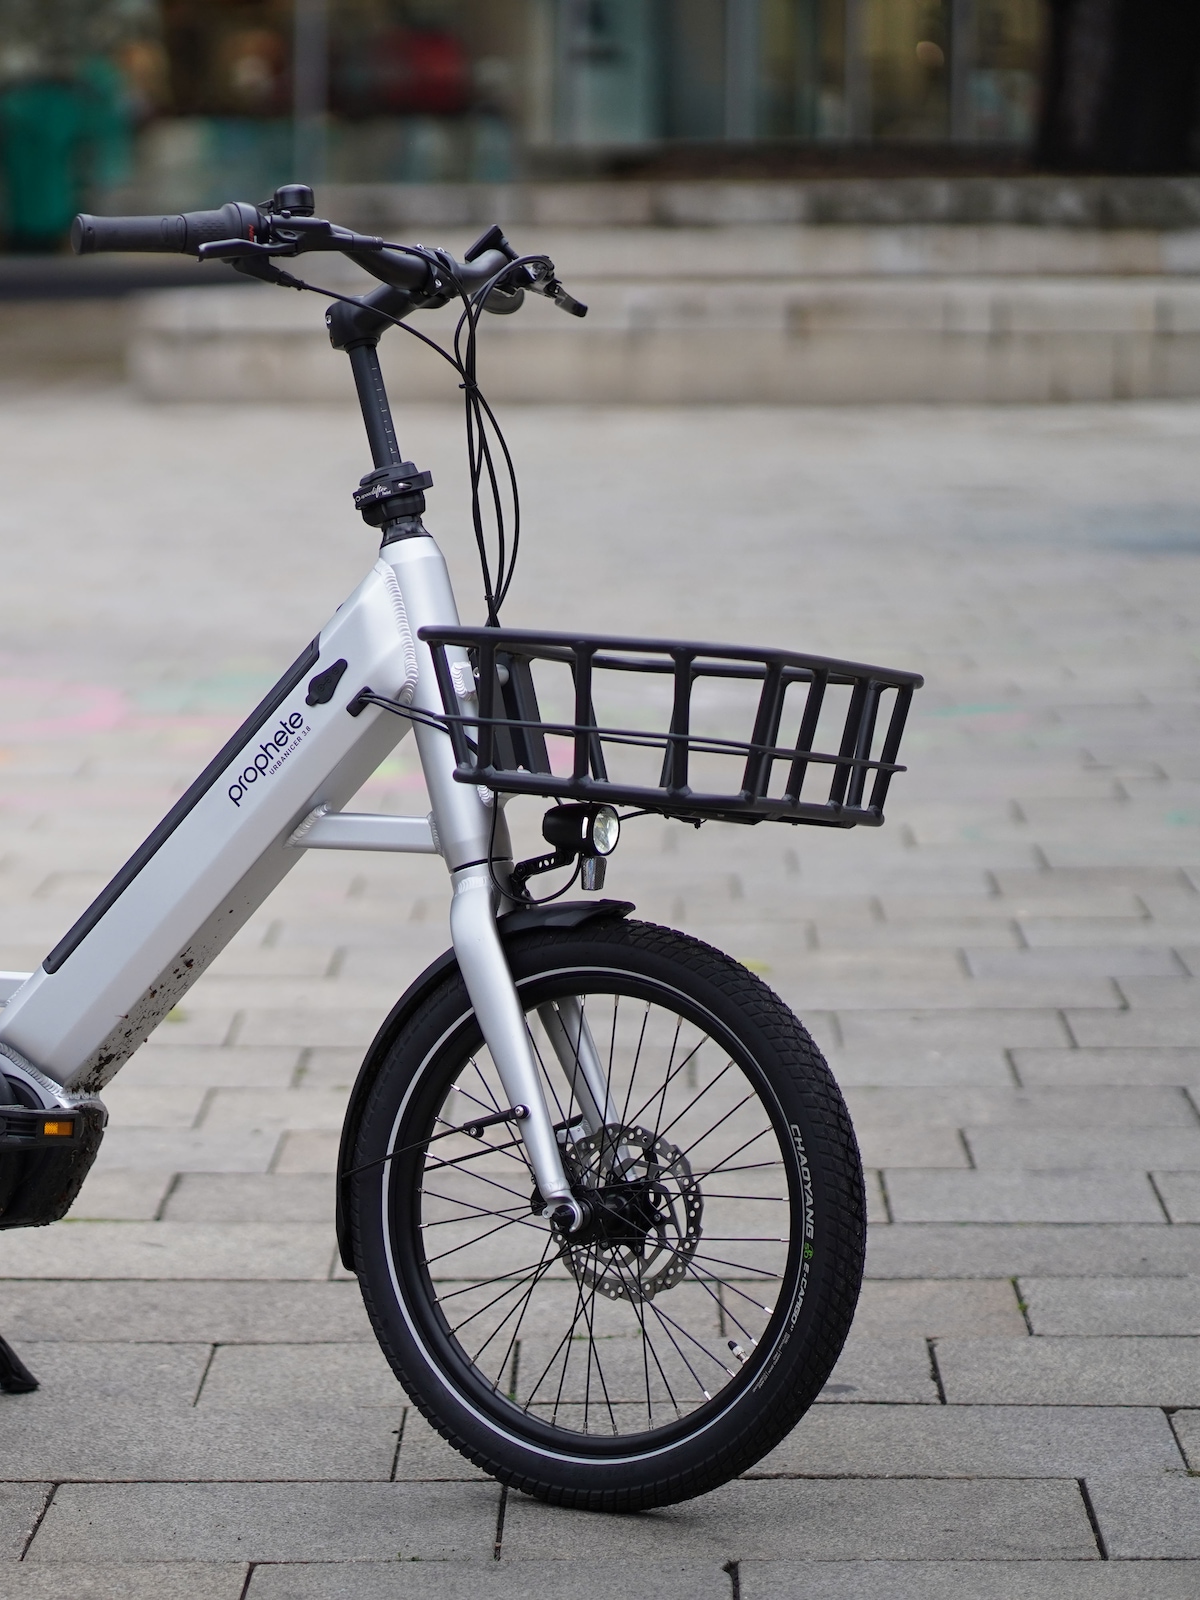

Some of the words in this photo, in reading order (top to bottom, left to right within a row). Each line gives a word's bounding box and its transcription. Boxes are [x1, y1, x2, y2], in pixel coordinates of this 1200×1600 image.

[228, 712, 304, 808] prophete
[268, 735, 303, 775] URBANICER
[790, 1123, 815, 1240] CHAOYANG
[790, 1262, 810, 1325] E-CARGO
